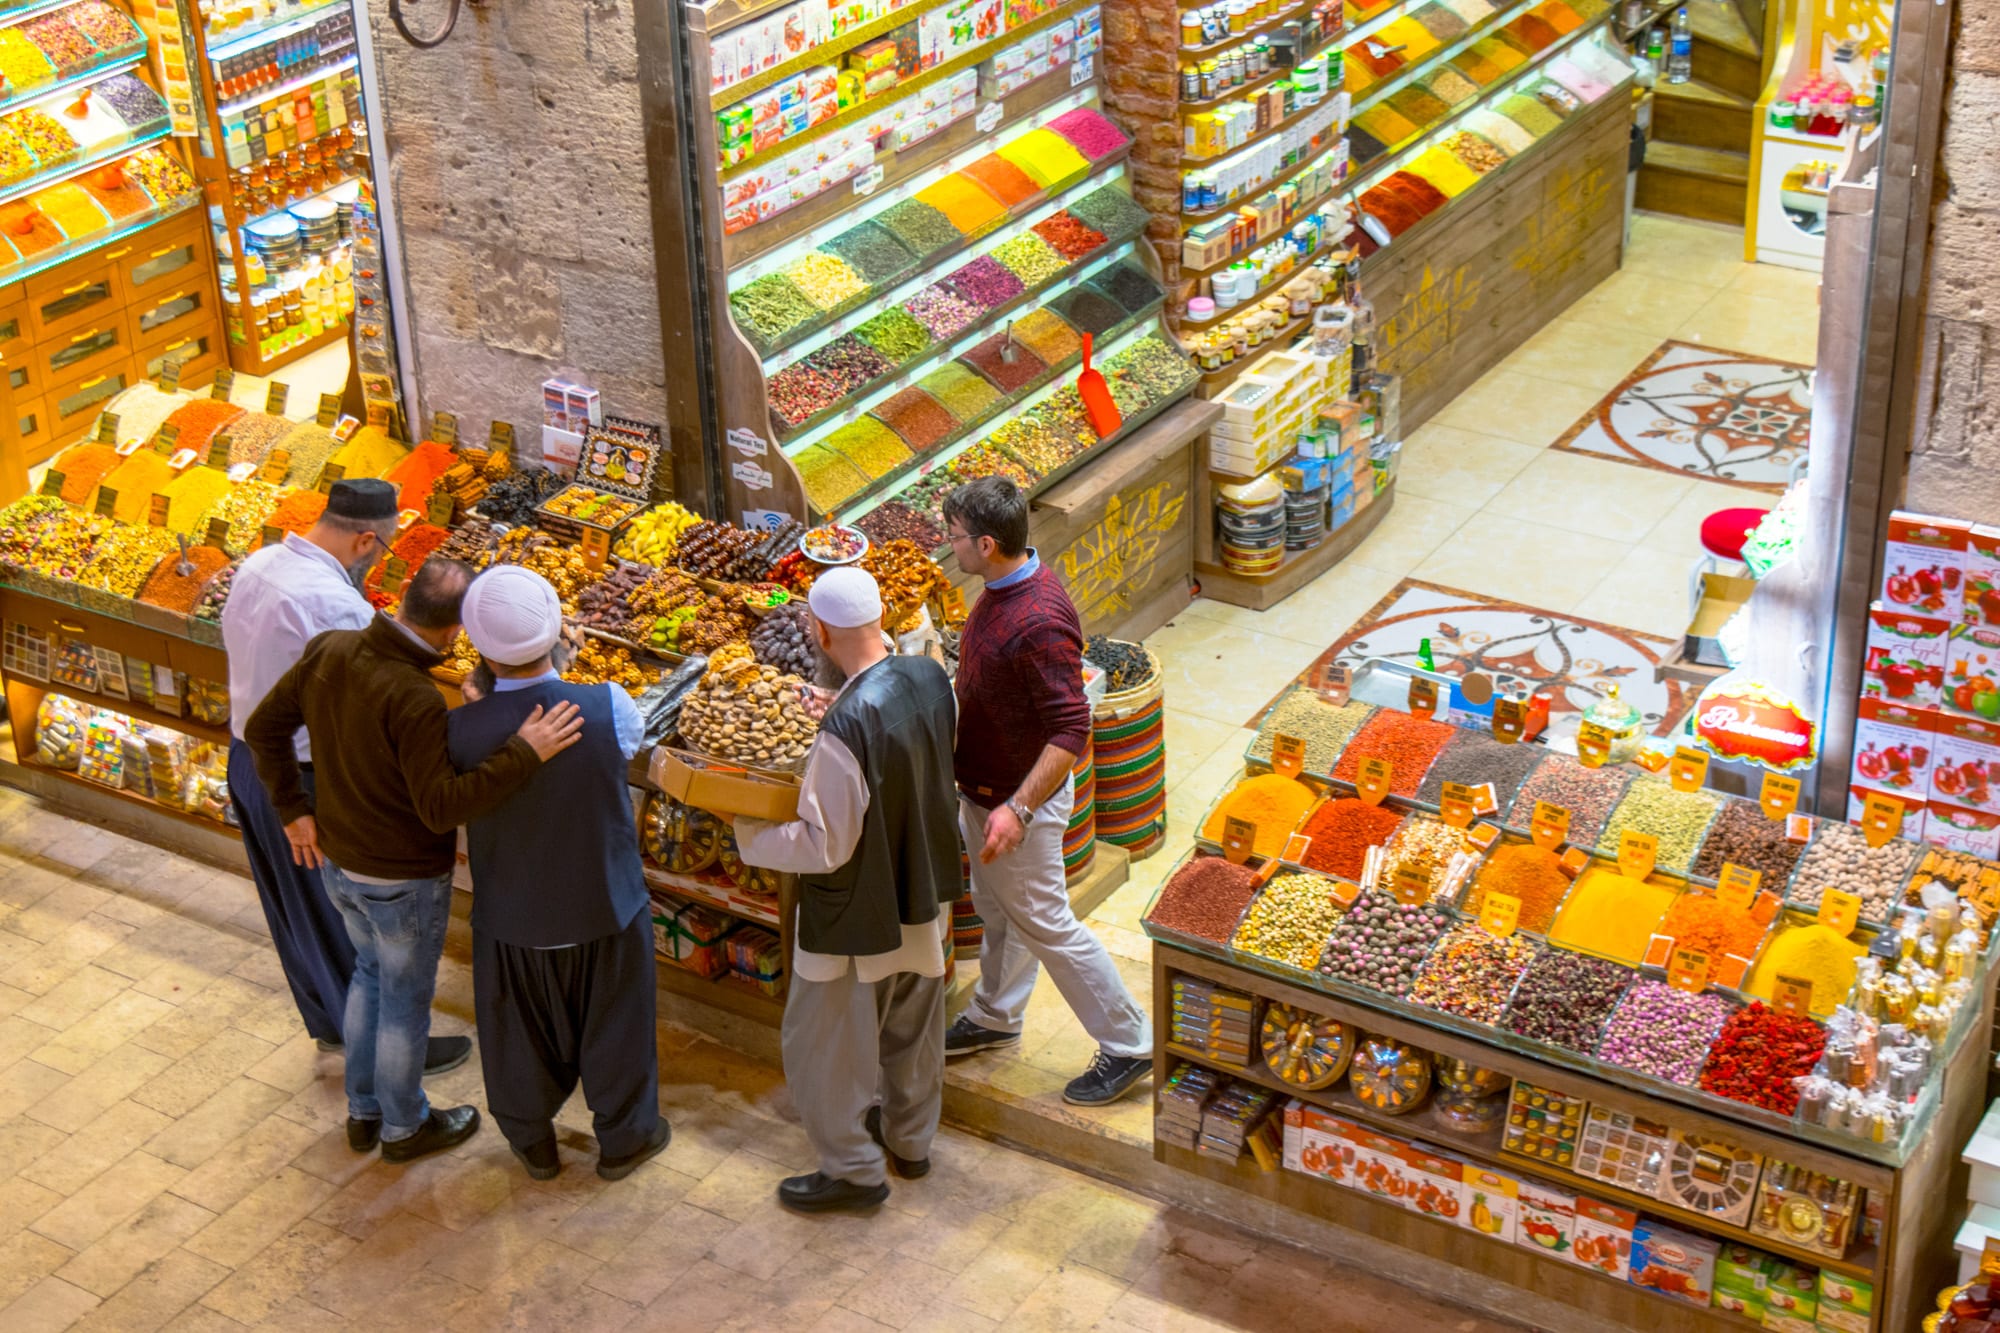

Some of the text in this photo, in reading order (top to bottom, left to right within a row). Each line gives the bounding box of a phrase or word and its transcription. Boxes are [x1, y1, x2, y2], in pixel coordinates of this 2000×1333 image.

[729, 434, 765, 450] Natural Tea
[1328, 675, 1345, 683] PEPPER
[1282, 744, 1296, 753] SPICE
[1366, 767, 1384, 777] PEPPER
[1544, 813, 1558, 823] SPICE
